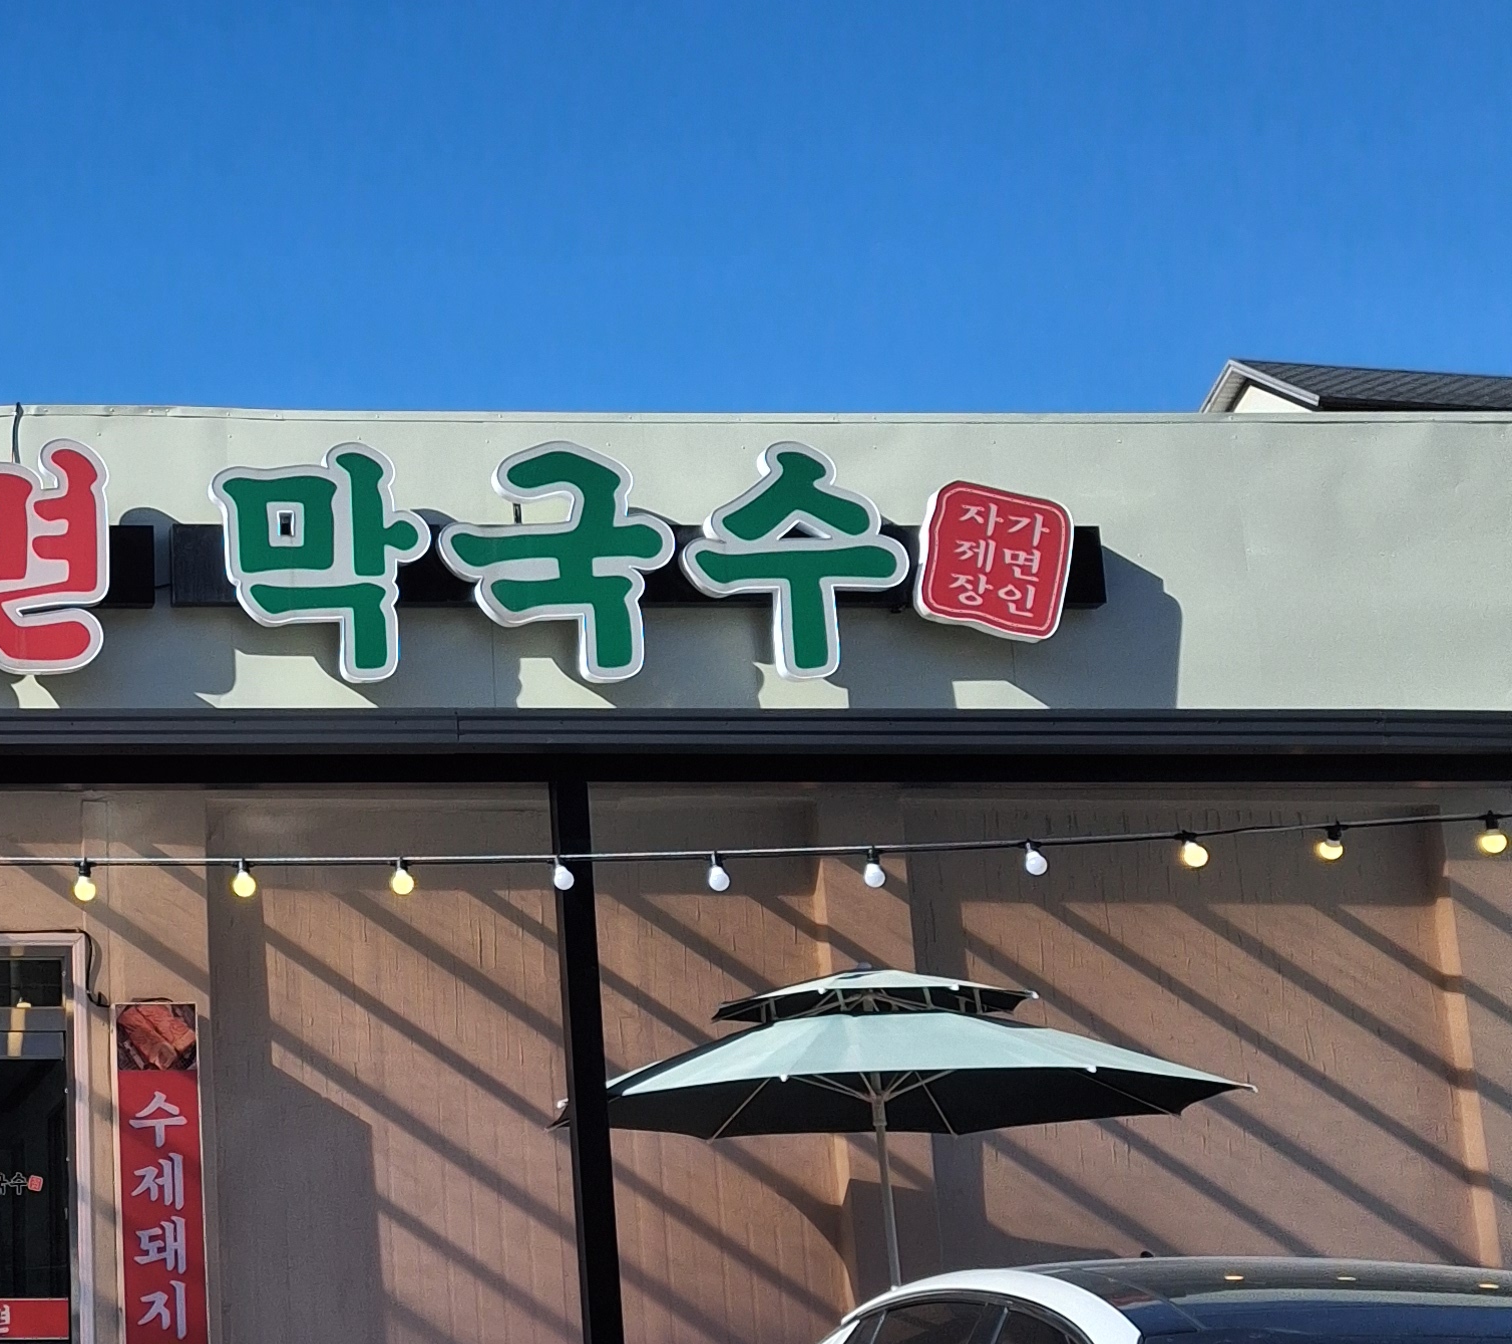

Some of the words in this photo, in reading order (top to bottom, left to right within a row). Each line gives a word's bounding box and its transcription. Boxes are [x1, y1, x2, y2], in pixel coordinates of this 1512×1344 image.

[959, 503, 1050, 547] 자가
[209, 441, 909, 682] 막국수
[954, 539, 1041, 582] 제면
[949, 573, 1035, 617] 장인
